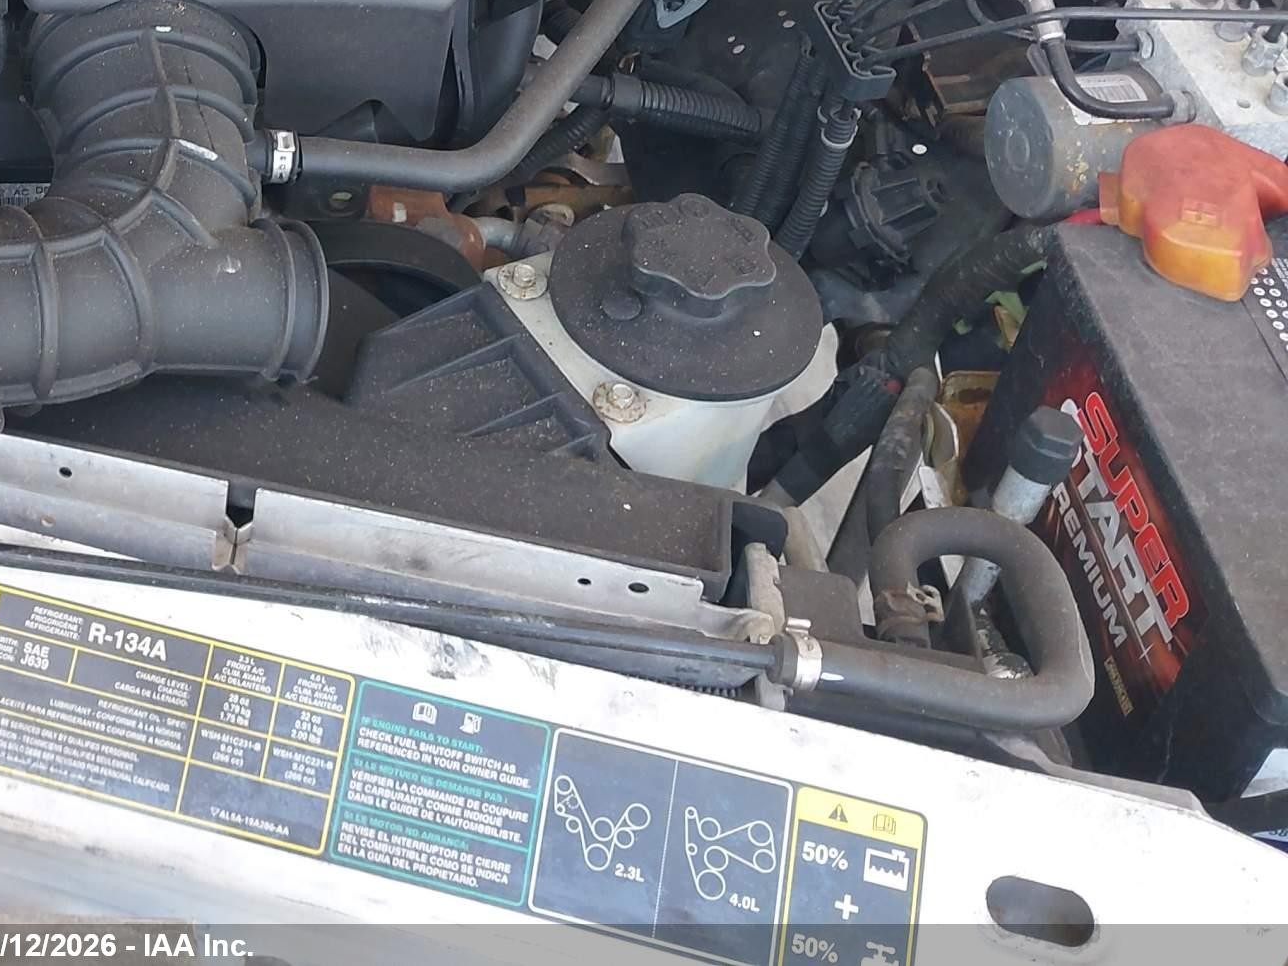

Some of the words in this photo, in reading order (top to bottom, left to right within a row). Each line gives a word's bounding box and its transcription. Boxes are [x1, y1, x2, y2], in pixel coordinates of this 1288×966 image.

[1085, 391, 1190, 630] SUPER
[22, 640, 51, 659] SAE
[86, 621, 170, 661] R-134A
[19, 652, 50, 671] J639
[225, 659, 251, 672] FRONT
[297, 677, 323, 690] FRONT
[358, 726, 393, 743] CHECK
[392, 734, 419, 749] FUEL
[418, 740, 463, 761] SHUTOFF
[463, 752, 502, 771] SWITCH
[501, 761, 518, 774] AS
[435, 734, 450, 745] TO
[356, 736, 421, 761] REFERENCED
[420, 752, 434, 764] IN
[432, 755, 461, 771] YOUR
[460, 762, 499, 781] OWNER
[346, 789, 374, 805] DANS
[374, 796, 388, 809] LE
[388, 800, 420, 817] GUIDE
[419, 808, 435, 821] DE
[348, 779, 363, 792] DE
[424, 798, 462, 817] COMME
[394, 780, 410, 792] LA
[408, 783, 465, 807] COMMANDE
[465, 798, 481, 810] DE
[480, 801, 530, 823] COUPURE
[336, 842, 353, 855] EN
[351, 846, 367, 859] LA
[391, 856, 412, 870] DEL
[338, 831, 359, 845] DEL
[358, 836, 428, 863] COMBUSTIBLE
[428, 854, 460, 871] COMO
[459, 863, 474, 875] SE
[474, 866, 510, 884] INDICA
[340, 820, 376, 838] REVISE
[376, 830, 391, 842] EL
[389, 833, 459, 860] INTERRUPTOR
[458, 852, 474, 864] DE
[473, 855, 512, 874] CIERRE
[802, 840, 849, 870] 50%
[614, 863, 645, 883] 2.3L
[729, 893, 760, 913] 4.0L
[791, 934, 838, 964] 50%
